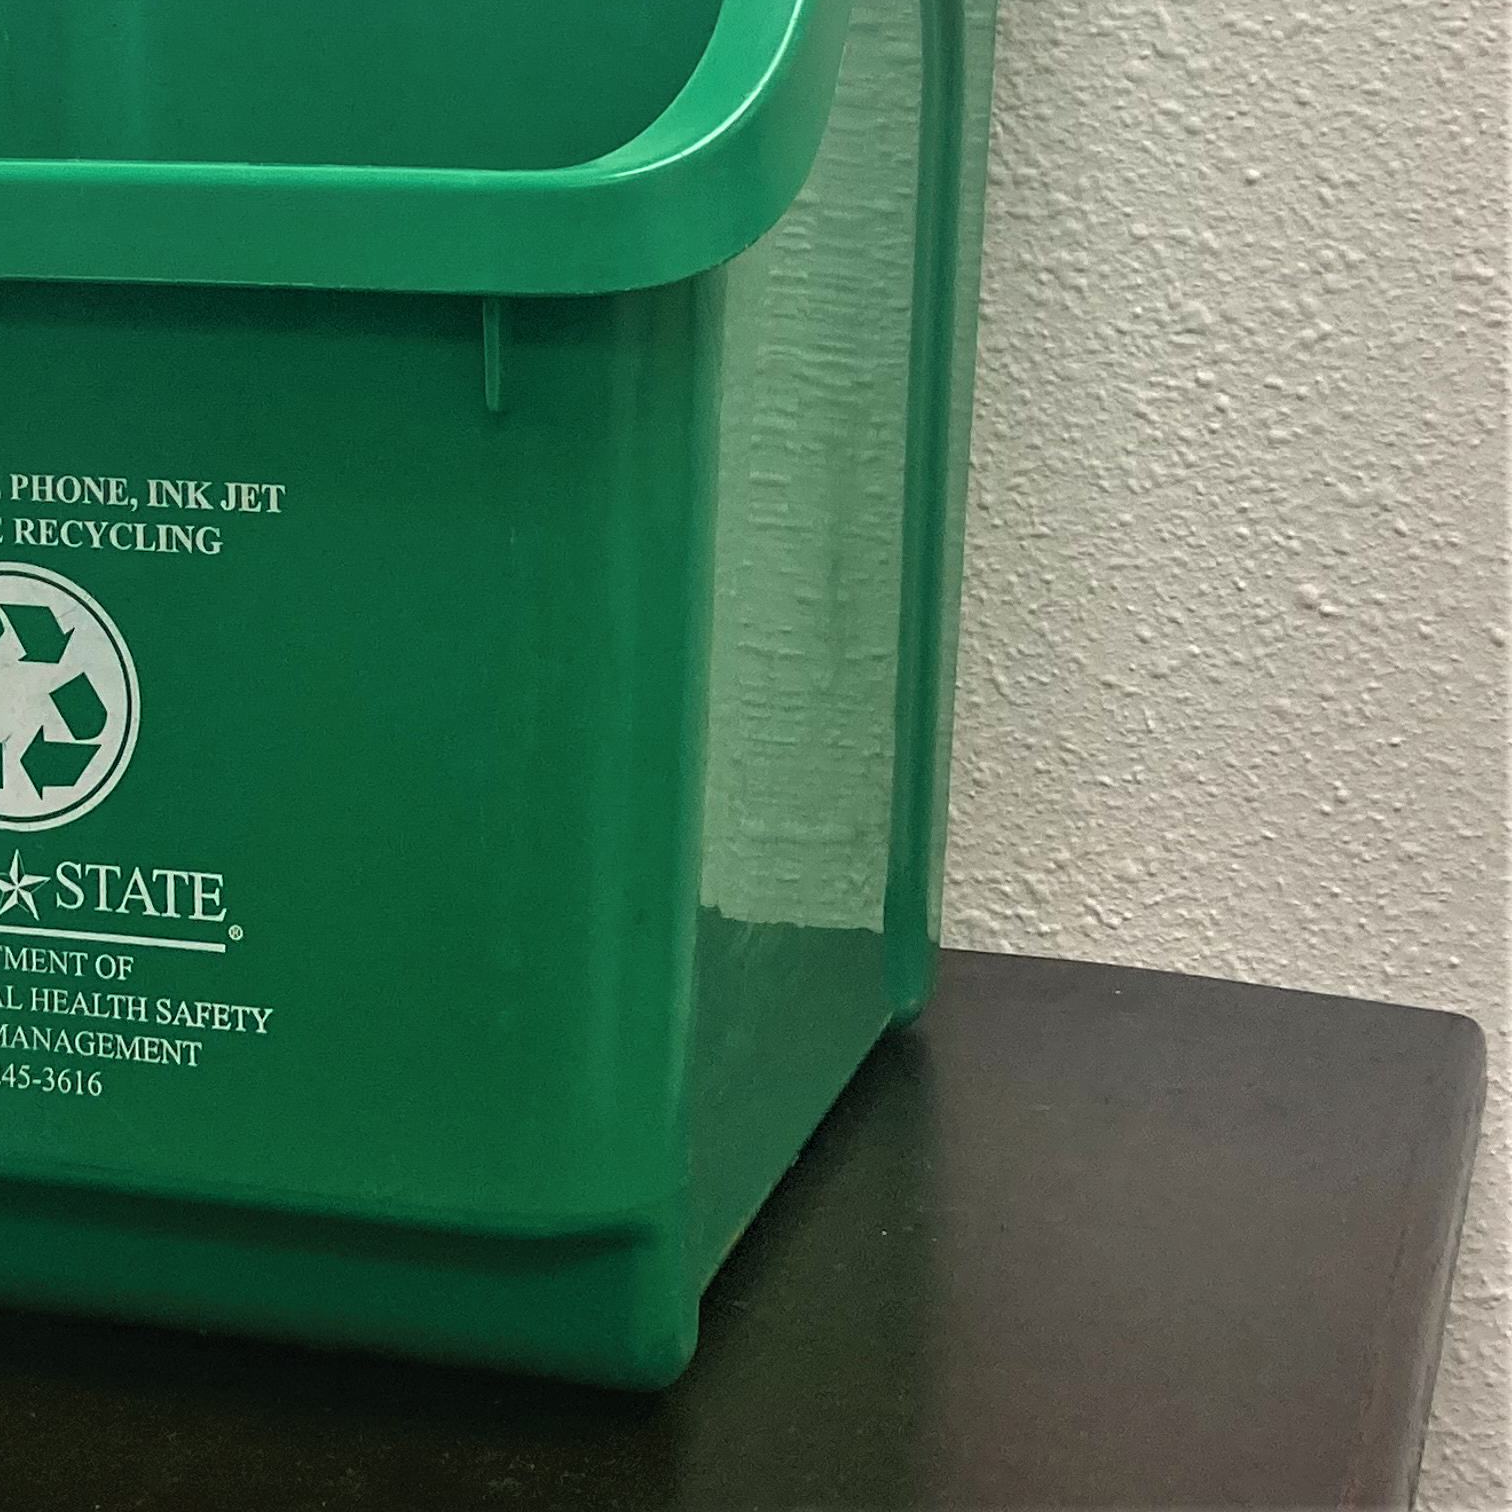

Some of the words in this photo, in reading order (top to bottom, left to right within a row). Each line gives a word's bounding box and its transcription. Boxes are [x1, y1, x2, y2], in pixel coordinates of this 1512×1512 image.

[10, 473, 138, 512] PHONE,
[147, 479, 214, 511] INK
[220, 481, 286, 513] JET
[13, 517, 223, 555] RECYCLING
[55, 860, 227, 923] STATE
[95, 953, 134, 981] OF
[31, 987, 149, 1023] HEALTH
[155, 998, 274, 1034] SAFETY
